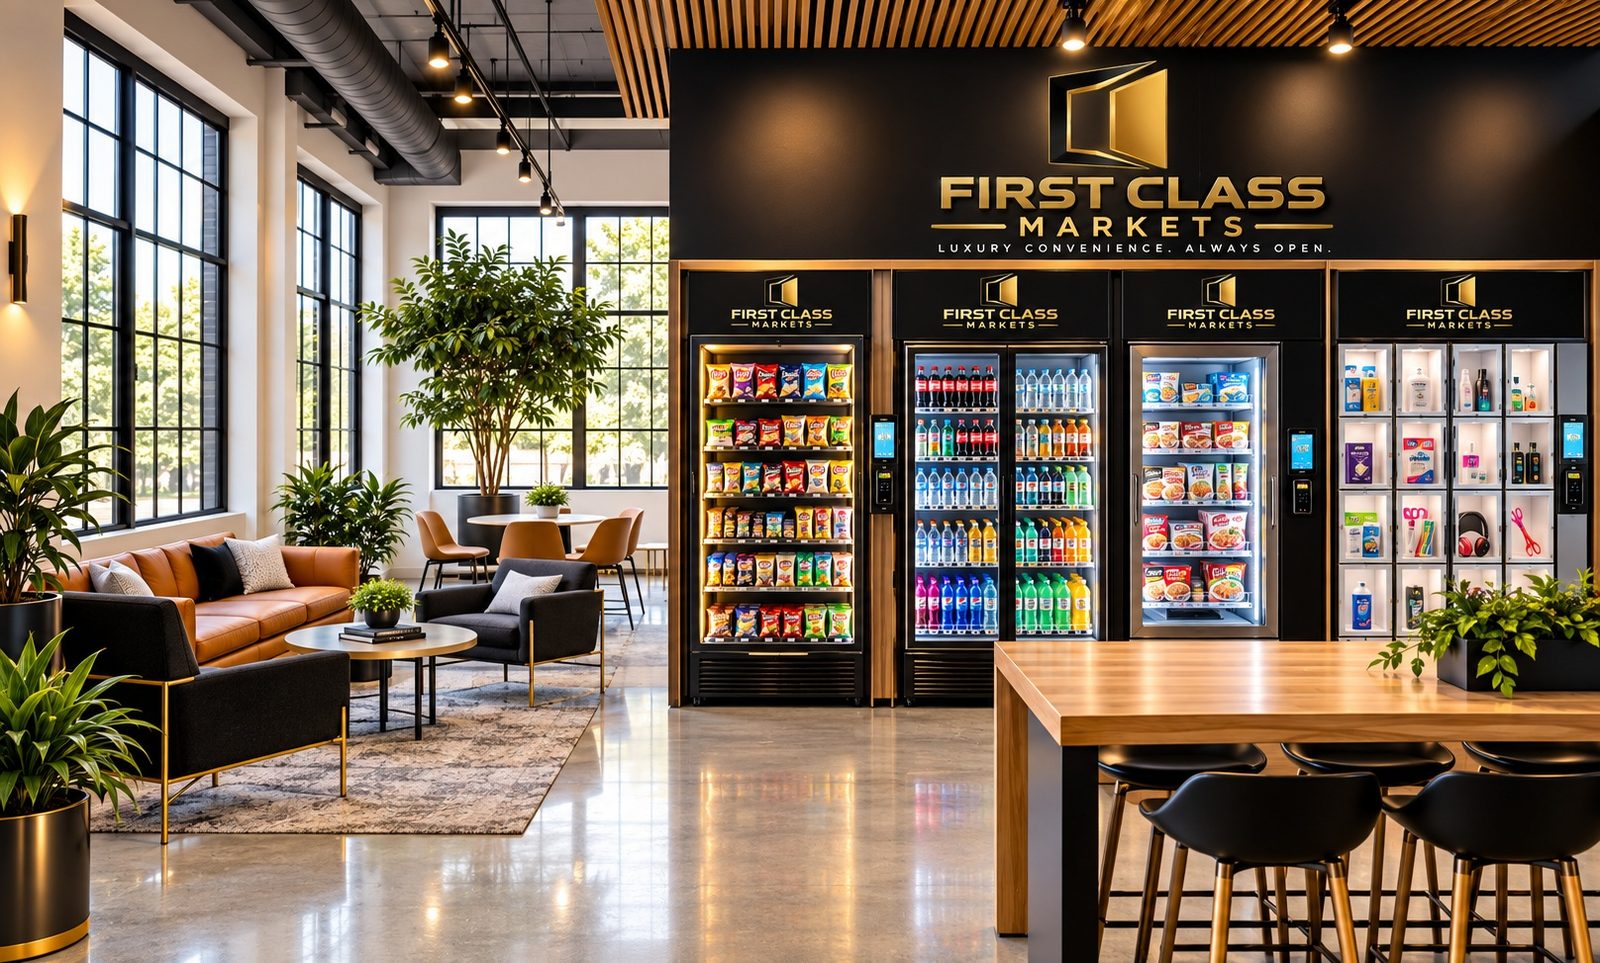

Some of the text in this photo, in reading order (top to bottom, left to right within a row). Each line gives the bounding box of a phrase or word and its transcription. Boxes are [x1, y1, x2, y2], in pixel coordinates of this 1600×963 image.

[940, 176, 1326, 209] FIRST CLASS
[1019, 216, 1243, 238] MARKETS
[938, 243, 1332, 254] LUXURY CONVENIENCE. ALWAYS OPEN.
[731, 308, 833, 320] FIRST CLASS
[943, 308, 1059, 320] FIRST CLASS
[1167, 308, 1276, 320] FIRST CLASS
[1406, 308, 1513, 320] FIRST CLASS
[751, 320, 813, 329] MARKETS
[966, 320, 1035, 330] MARKETS
[1188, 320, 1253, 330] MARKETS
[1427, 320, 1492, 330] MARKETS
